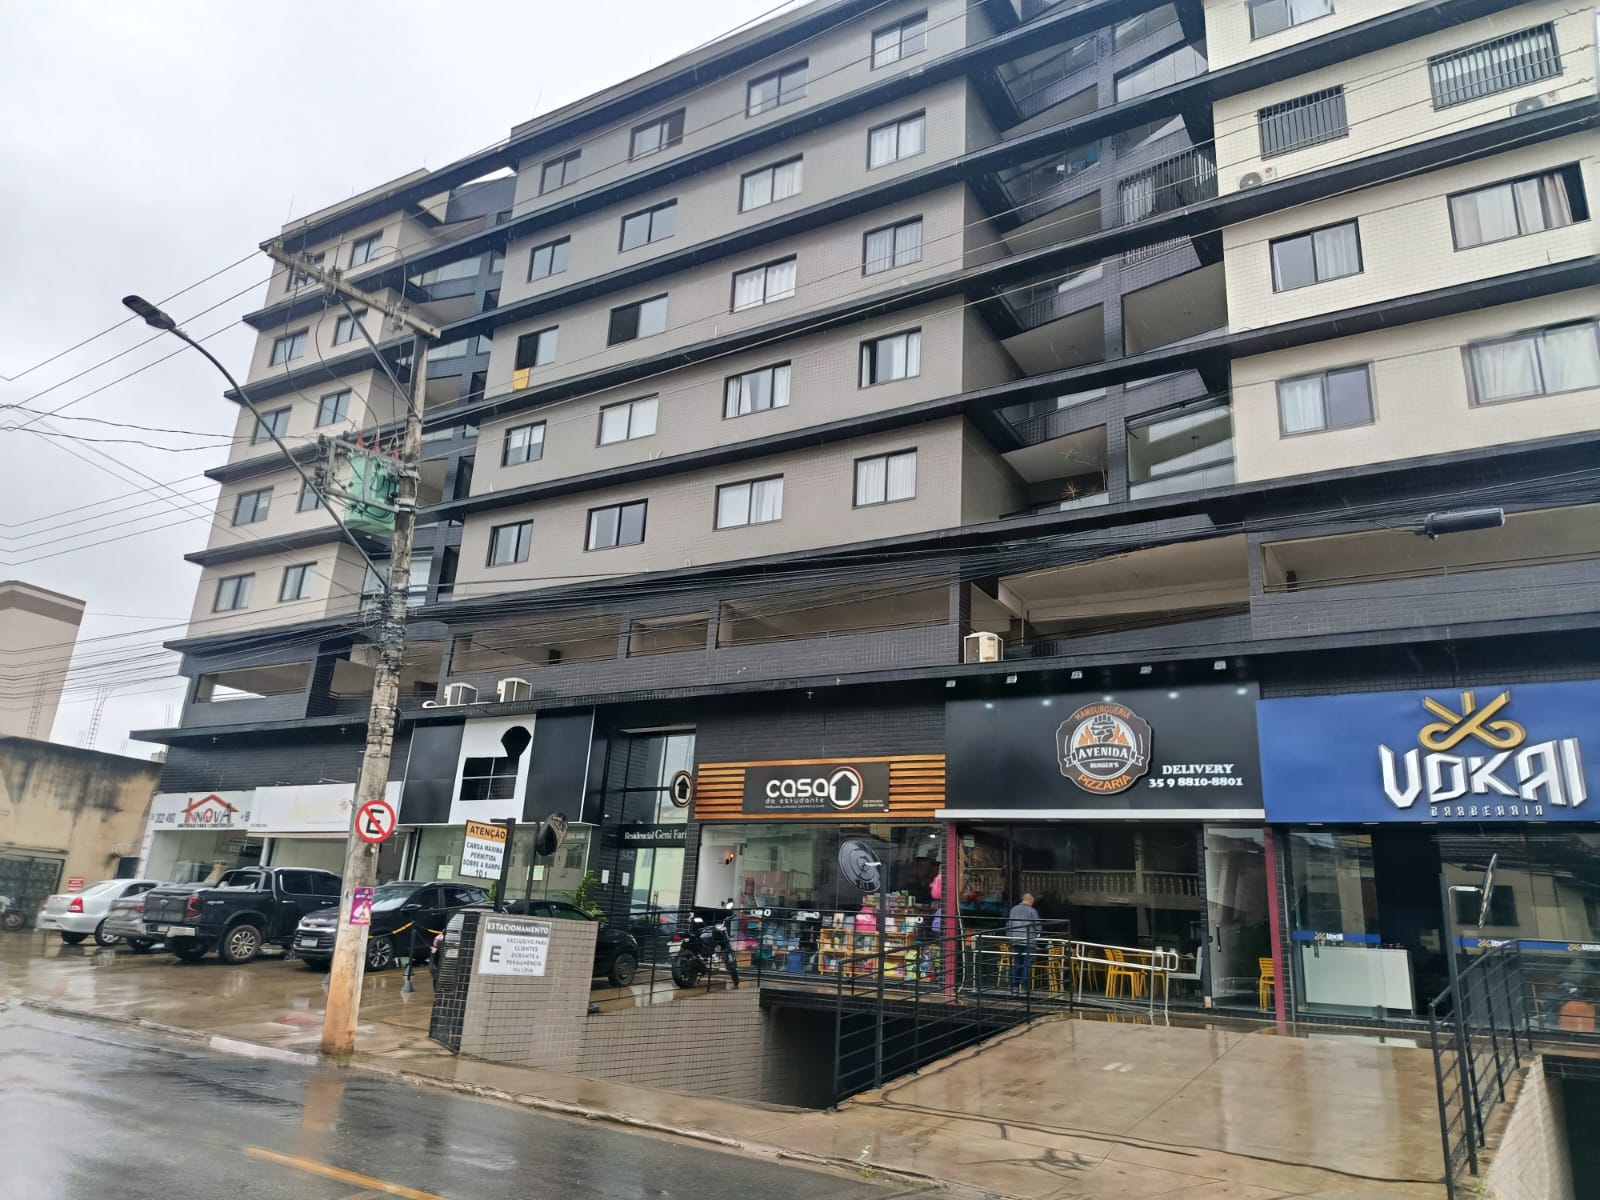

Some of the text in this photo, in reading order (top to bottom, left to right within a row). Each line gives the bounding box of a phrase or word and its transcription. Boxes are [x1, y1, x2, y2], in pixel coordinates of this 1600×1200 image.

[1074, 705, 1132, 720] HAMBURGUERIA
[1078, 747, 1129, 760] AVENIDA
[1162, 763, 1235, 775] DELIVERY
[1378, 738, 1588, 809] VOKAI
[1077, 773, 1132, 790] PIZZARIA
[1148, 776, 1244, 788] 35 9 8810-8801
[766, 778, 829, 798] casa
[779, 796, 825, 804] estudante
[624, 831, 655, 840] Residencial
[655, 829, 673, 840] Geni
[471, 852, 496, 862] PERMITIDA
[487, 922, 549, 934] ESTACIONAMENTO
[489, 945, 502, 963] E
